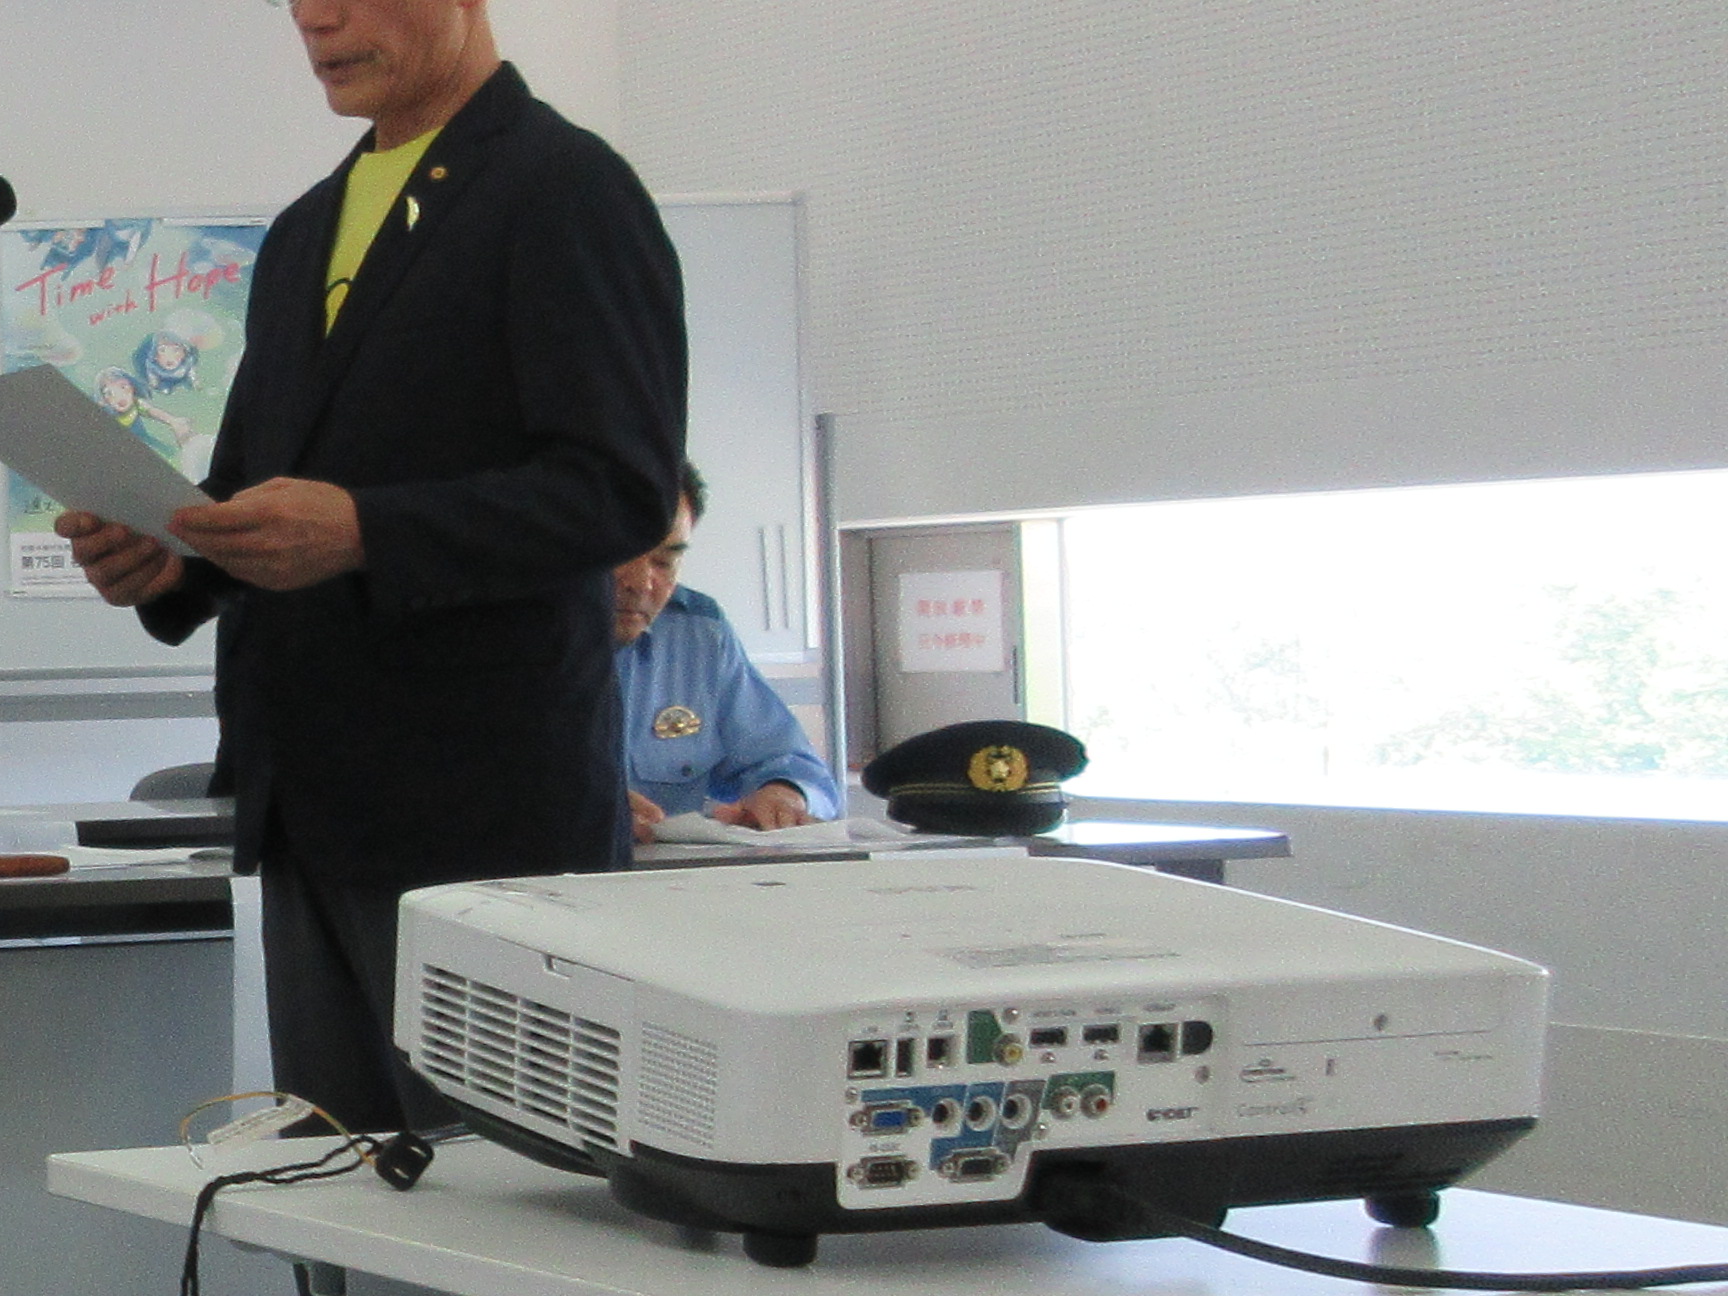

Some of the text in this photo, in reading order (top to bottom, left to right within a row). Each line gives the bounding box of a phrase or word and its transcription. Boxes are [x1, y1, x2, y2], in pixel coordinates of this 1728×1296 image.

[15, 250, 242, 326] Time with Hope
